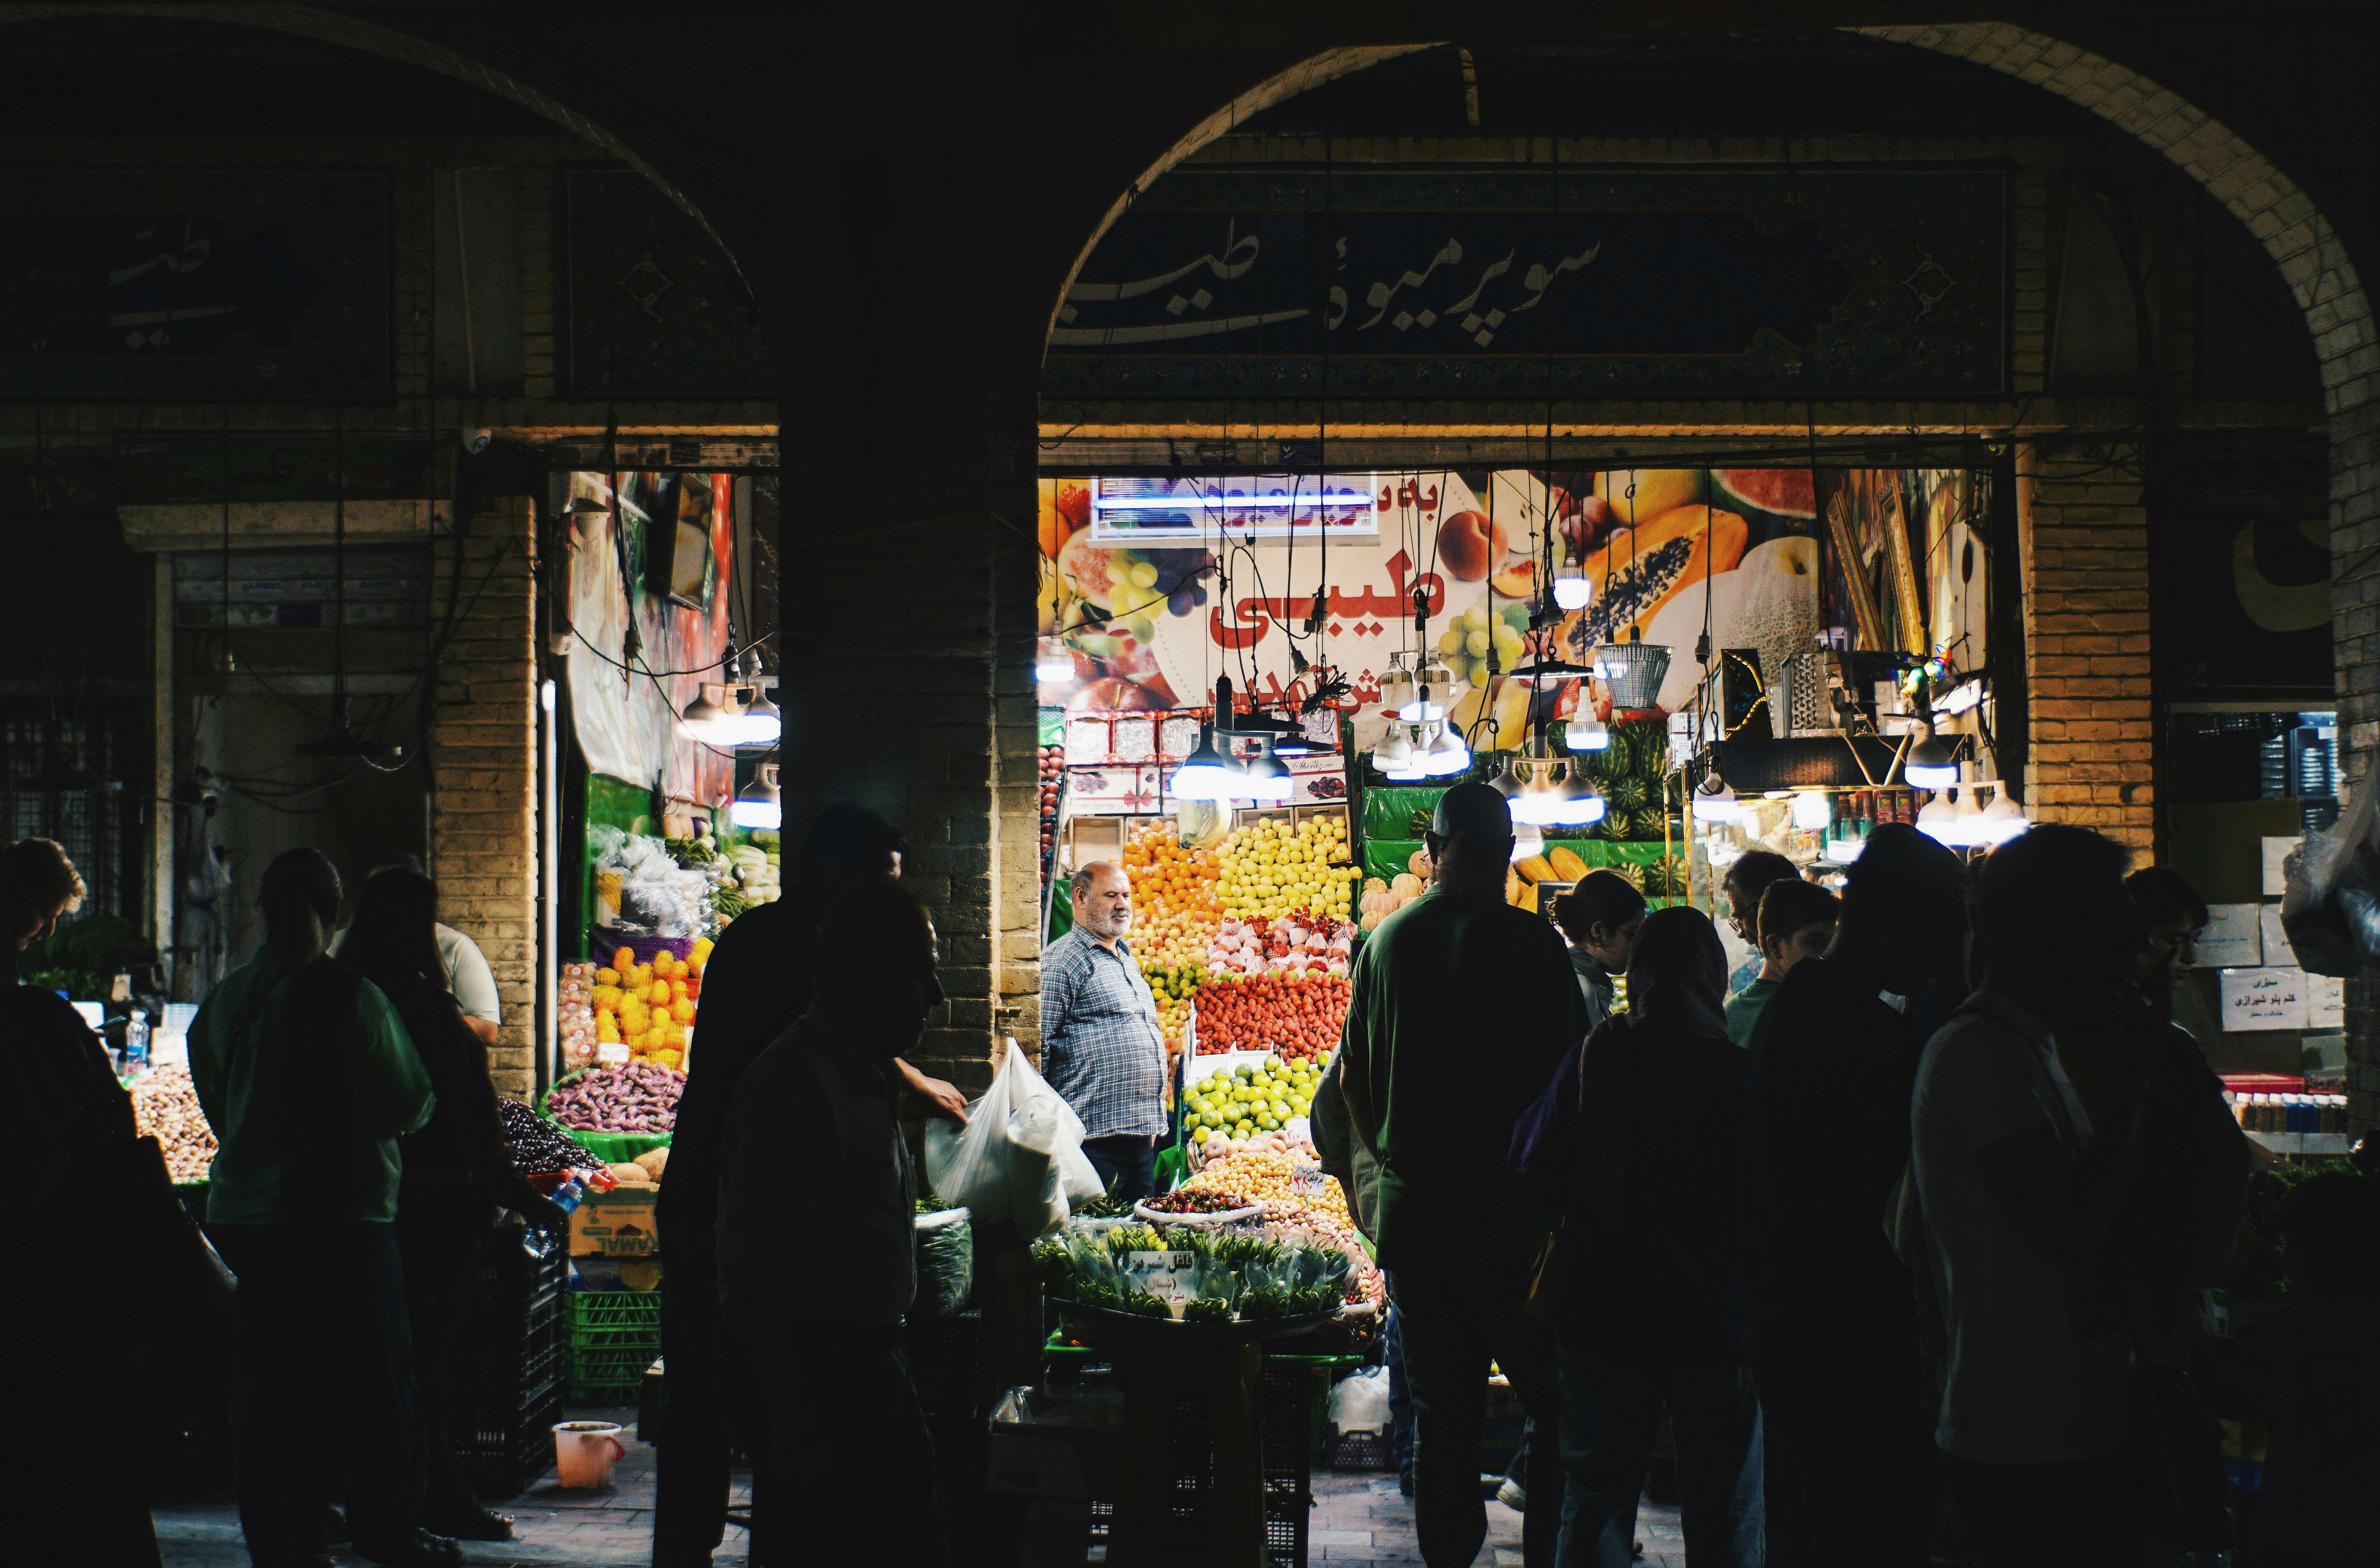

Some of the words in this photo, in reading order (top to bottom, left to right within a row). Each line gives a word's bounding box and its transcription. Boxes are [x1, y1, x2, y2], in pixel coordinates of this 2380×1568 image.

[1445, 240, 1601, 348] سوپر
[1210, 549, 1445, 649] طیبی
[1168, 1253, 1193, 1273] فلفل
